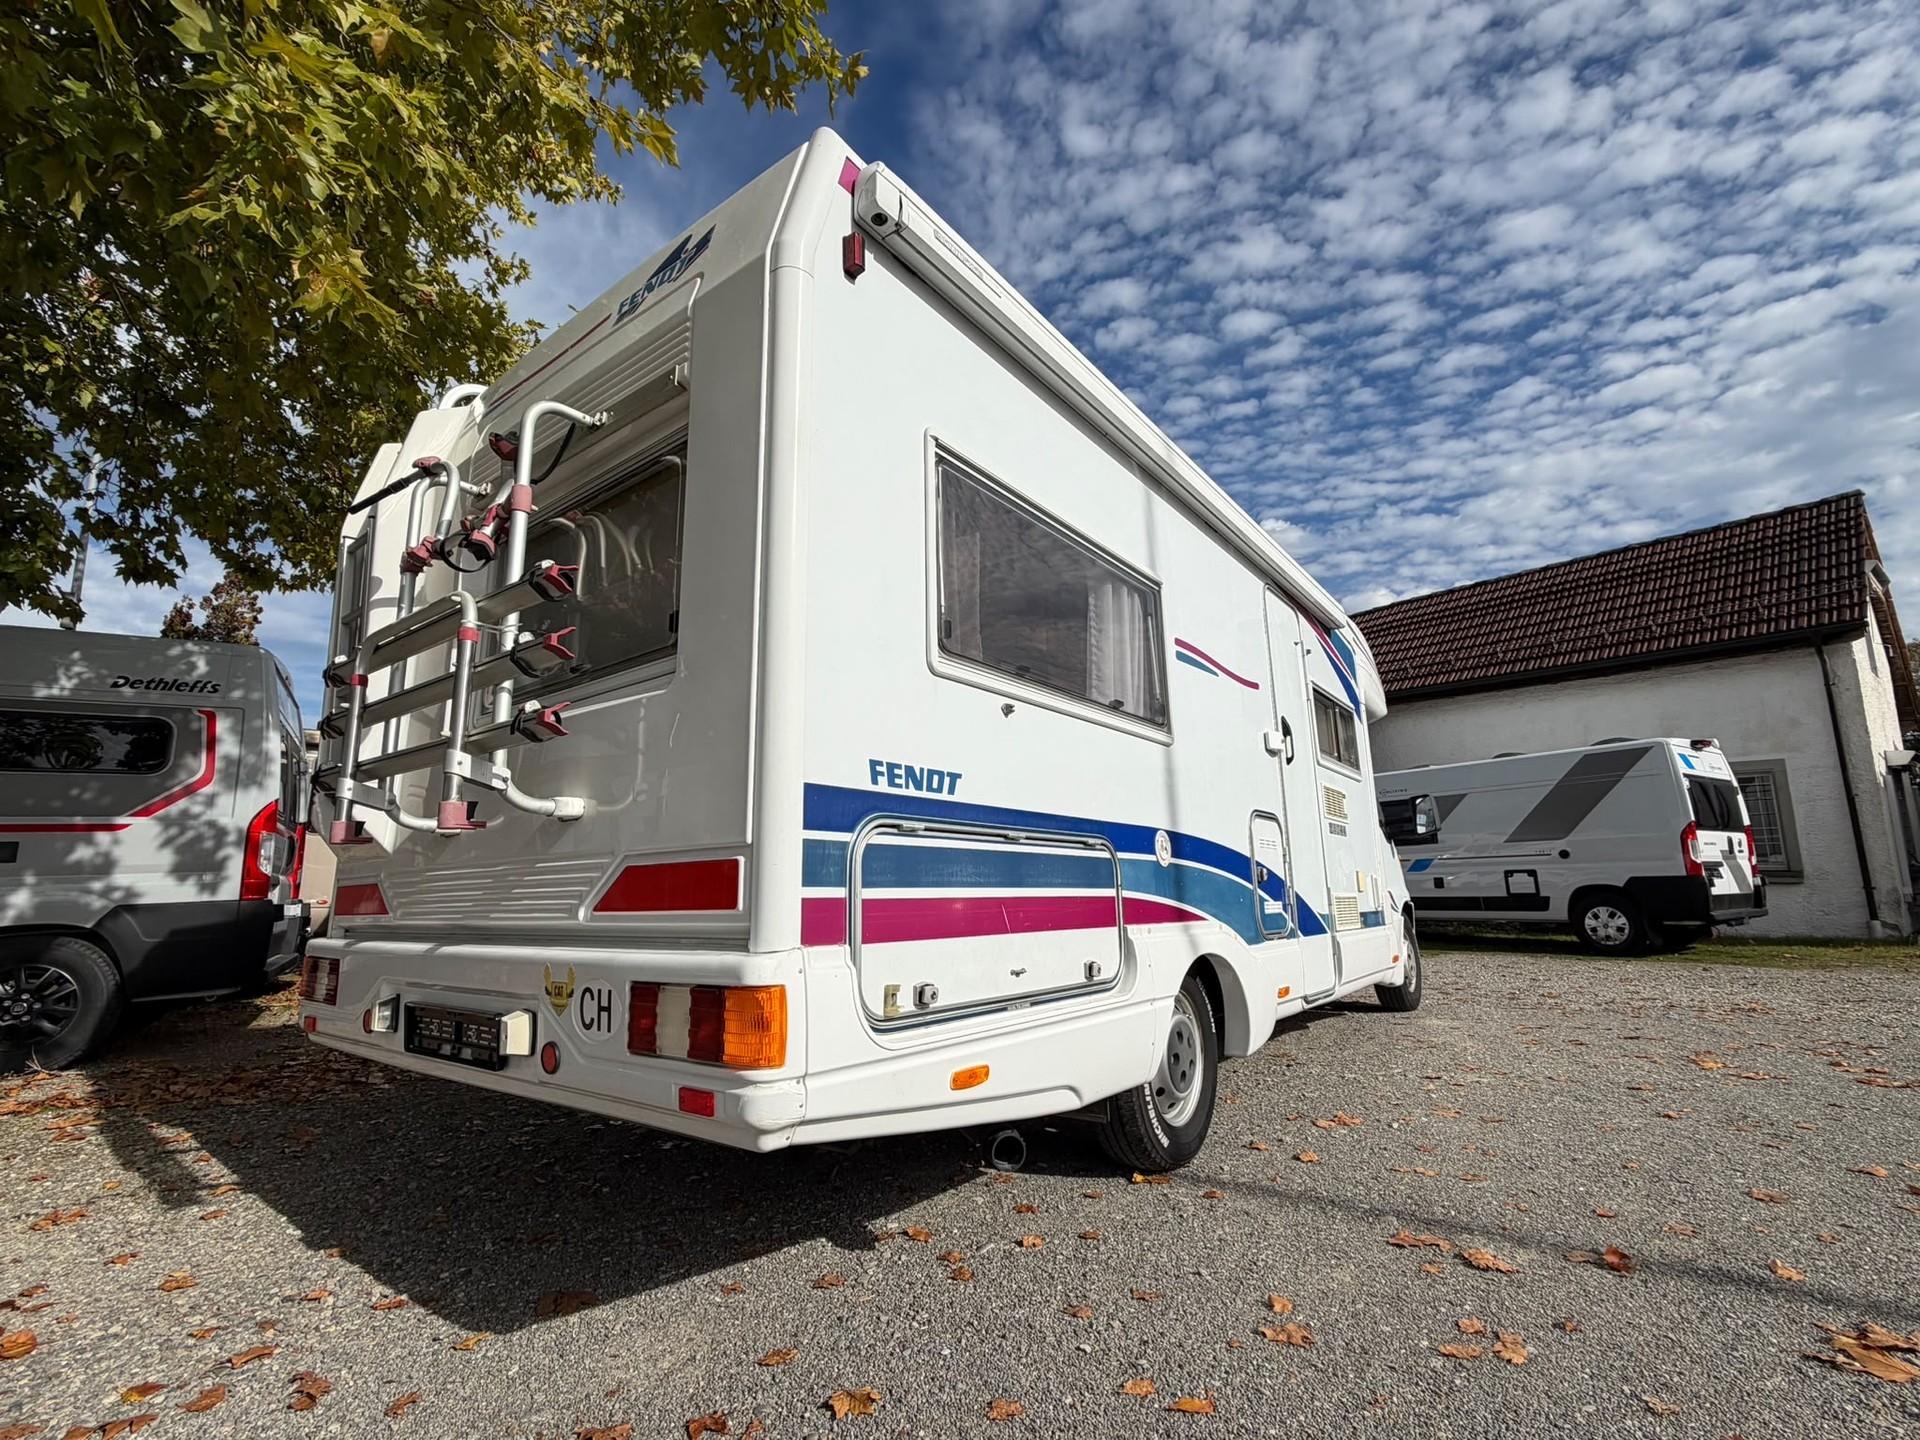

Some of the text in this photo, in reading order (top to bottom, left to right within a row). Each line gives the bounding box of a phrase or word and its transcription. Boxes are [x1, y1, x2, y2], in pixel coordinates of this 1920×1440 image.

[617, 248, 697, 316] FENDT
[109, 674, 221, 694] Dethleffs
[868, 758, 963, 796] FENDT
[580, 986, 612, 1033] CH
[1143, 1083, 1170, 1148] MICHELIN
